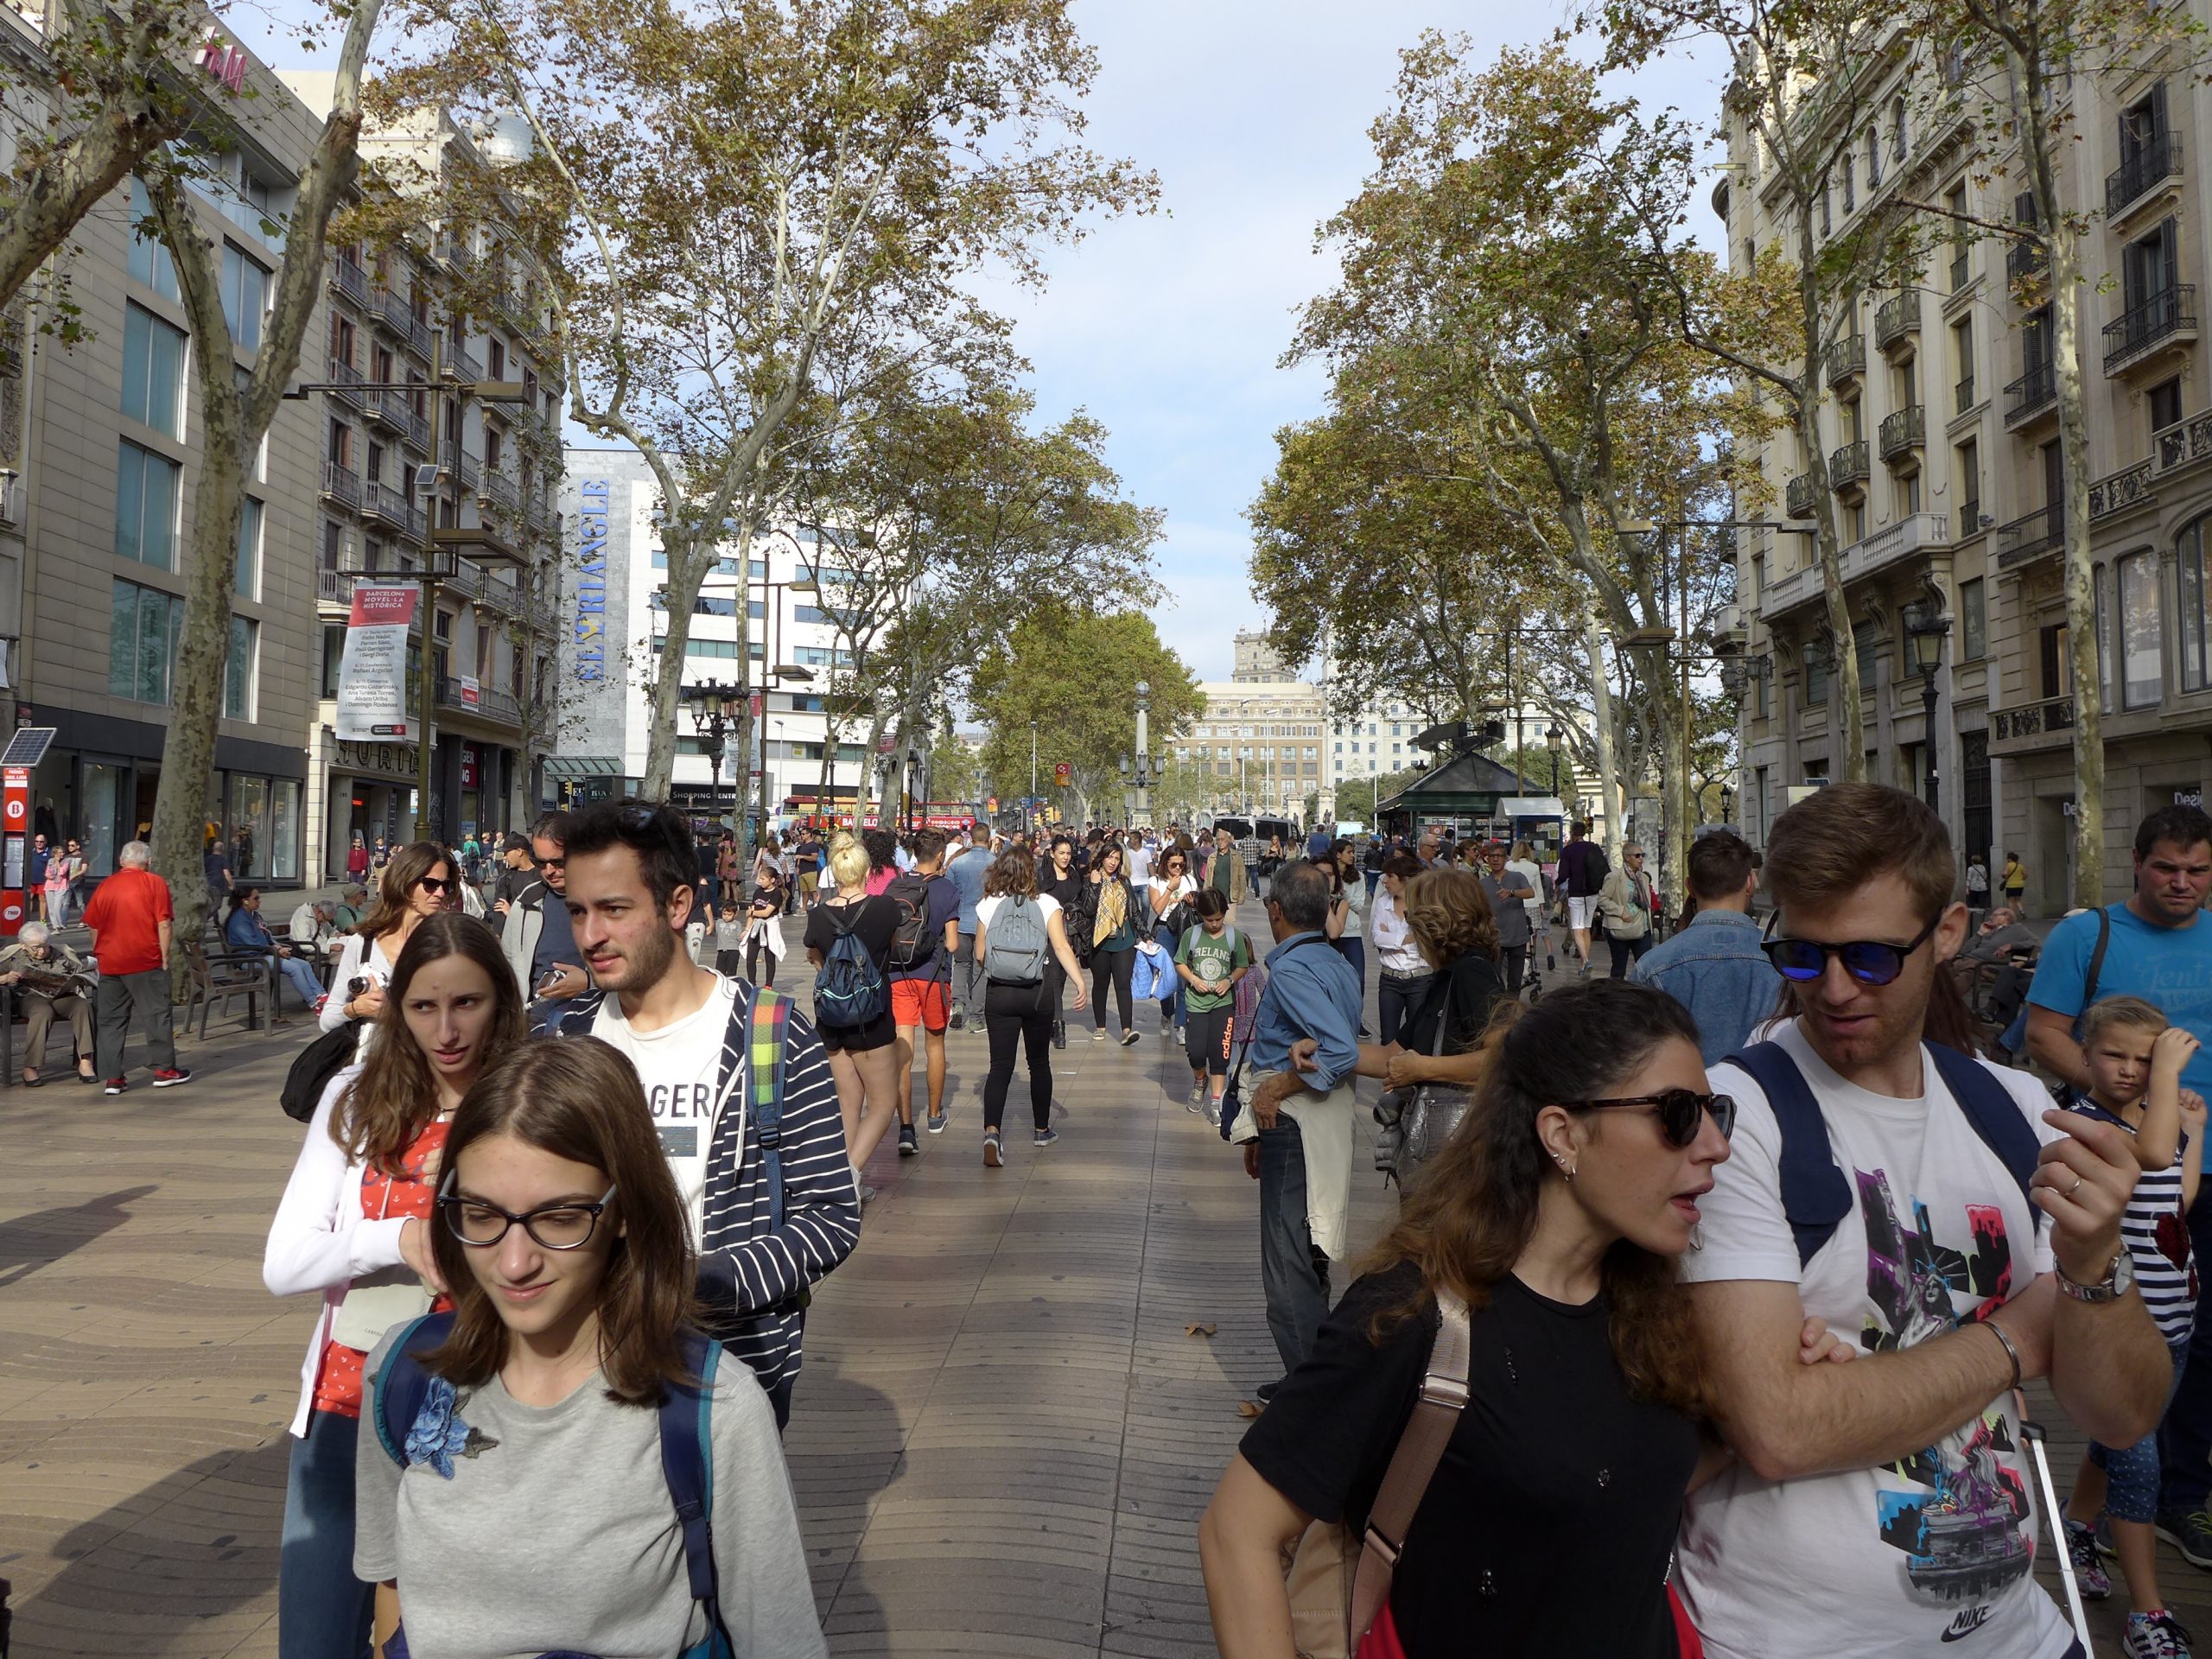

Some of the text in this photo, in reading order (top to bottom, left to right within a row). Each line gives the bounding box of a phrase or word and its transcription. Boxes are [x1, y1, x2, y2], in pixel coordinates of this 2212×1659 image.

[575, 479, 608, 645] TRIANGLE
[462, 749, 474, 765] GER
[1951, 1604, 1990, 1630] NIKE
